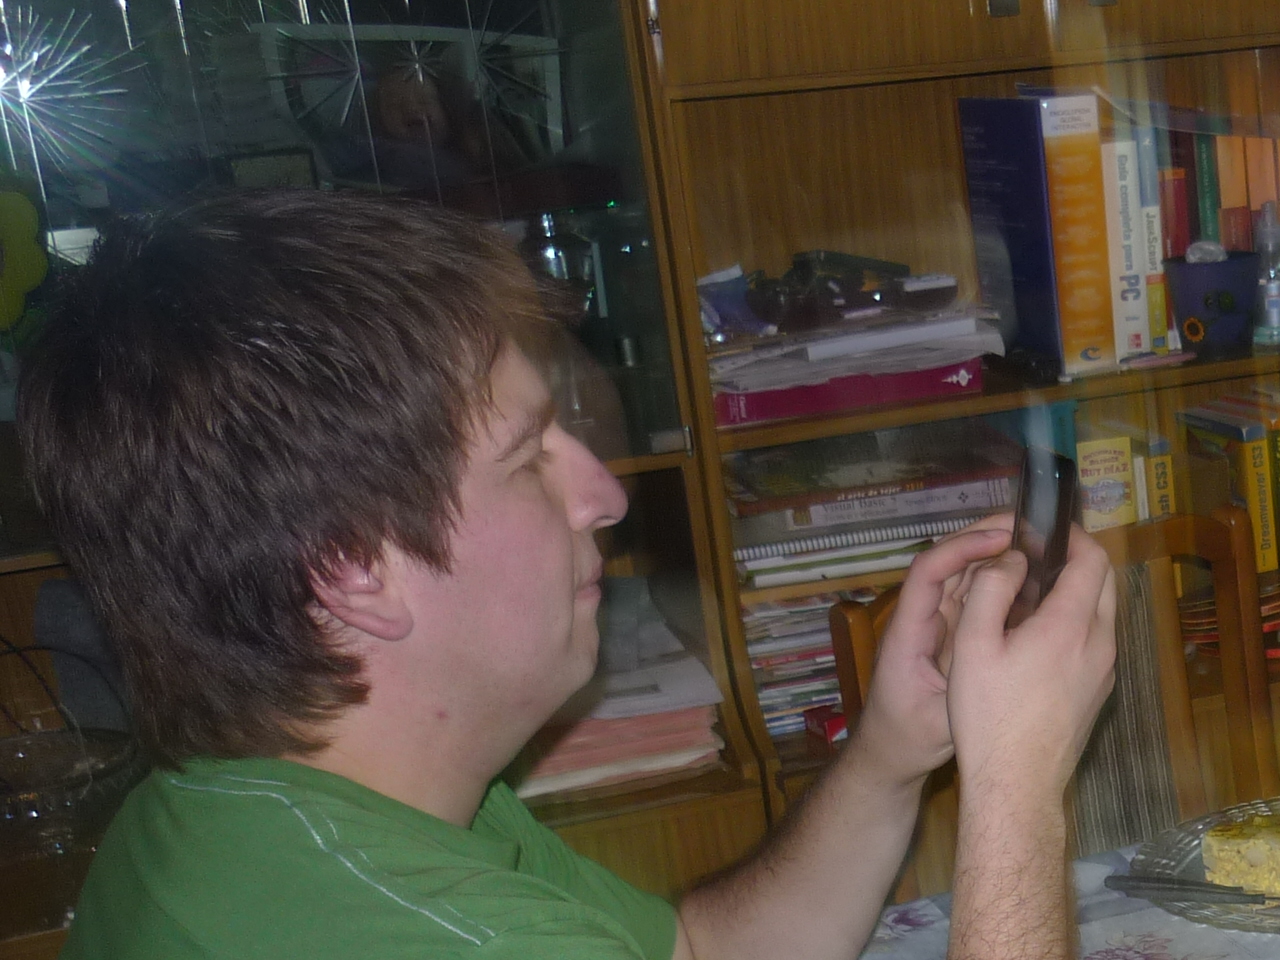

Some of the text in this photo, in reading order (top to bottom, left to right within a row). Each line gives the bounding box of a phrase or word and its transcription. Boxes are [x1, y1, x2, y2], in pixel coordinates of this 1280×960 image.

[1119, 274, 1141, 301] PC
[1154, 462, 1168, 490] CS3
[1252, 445, 1271, 551] Dreamweaver CS3
